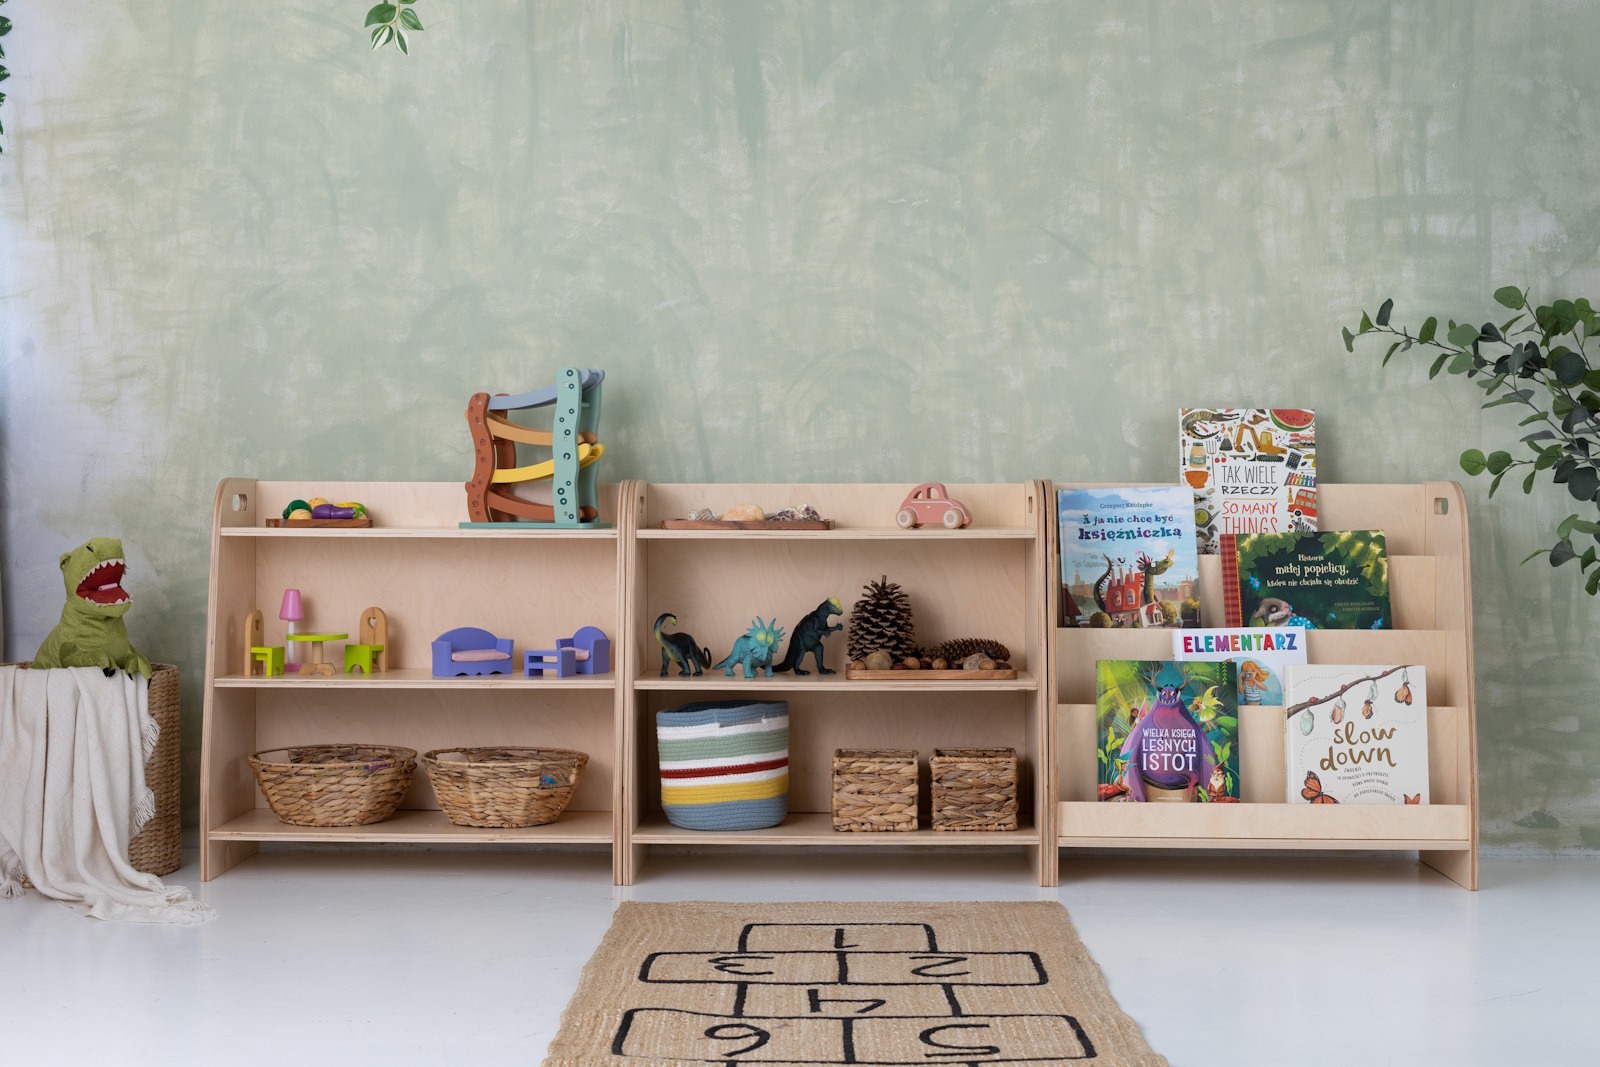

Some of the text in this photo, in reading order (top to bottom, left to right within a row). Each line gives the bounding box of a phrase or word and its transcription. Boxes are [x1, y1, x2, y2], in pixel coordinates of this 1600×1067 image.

[1222, 465, 1277, 484] TAK WIELE
[1221, 485, 1279, 495] RZECZY
[1100, 502, 1125, 510] Grzegorz
[1222, 501, 1278, 515] SO MANY
[1093, 516, 1105, 526] ja
[1106, 515, 1124, 524] nie
[1126, 515, 1152, 524] chcę
[1154, 514, 1174, 524] być
[1078, 527, 1182, 541] księżniczką
[1298, 554, 1324, 562] Historia
[1275, 562, 1349, 577] małej popielicy,
[1299, 579, 1322, 587] chciała
[1324, 579, 1333, 587] się
[1183, 633, 1298, 653] ELEMENTARZ
[1142, 728, 1196, 739] WIELKA KSIĘGA
[1333, 721, 1397, 745] slow
[1142, 738, 1196, 752] LEŚNYCH
[1142, 753, 1197, 771] ISTOT
[1320, 746, 1397, 771] down
[708, 955, 774, 976] 3
[908, 955, 972, 978] 2
[807, 988, 886, 1013] 4
[919, 1023, 1000, 1057] 5
